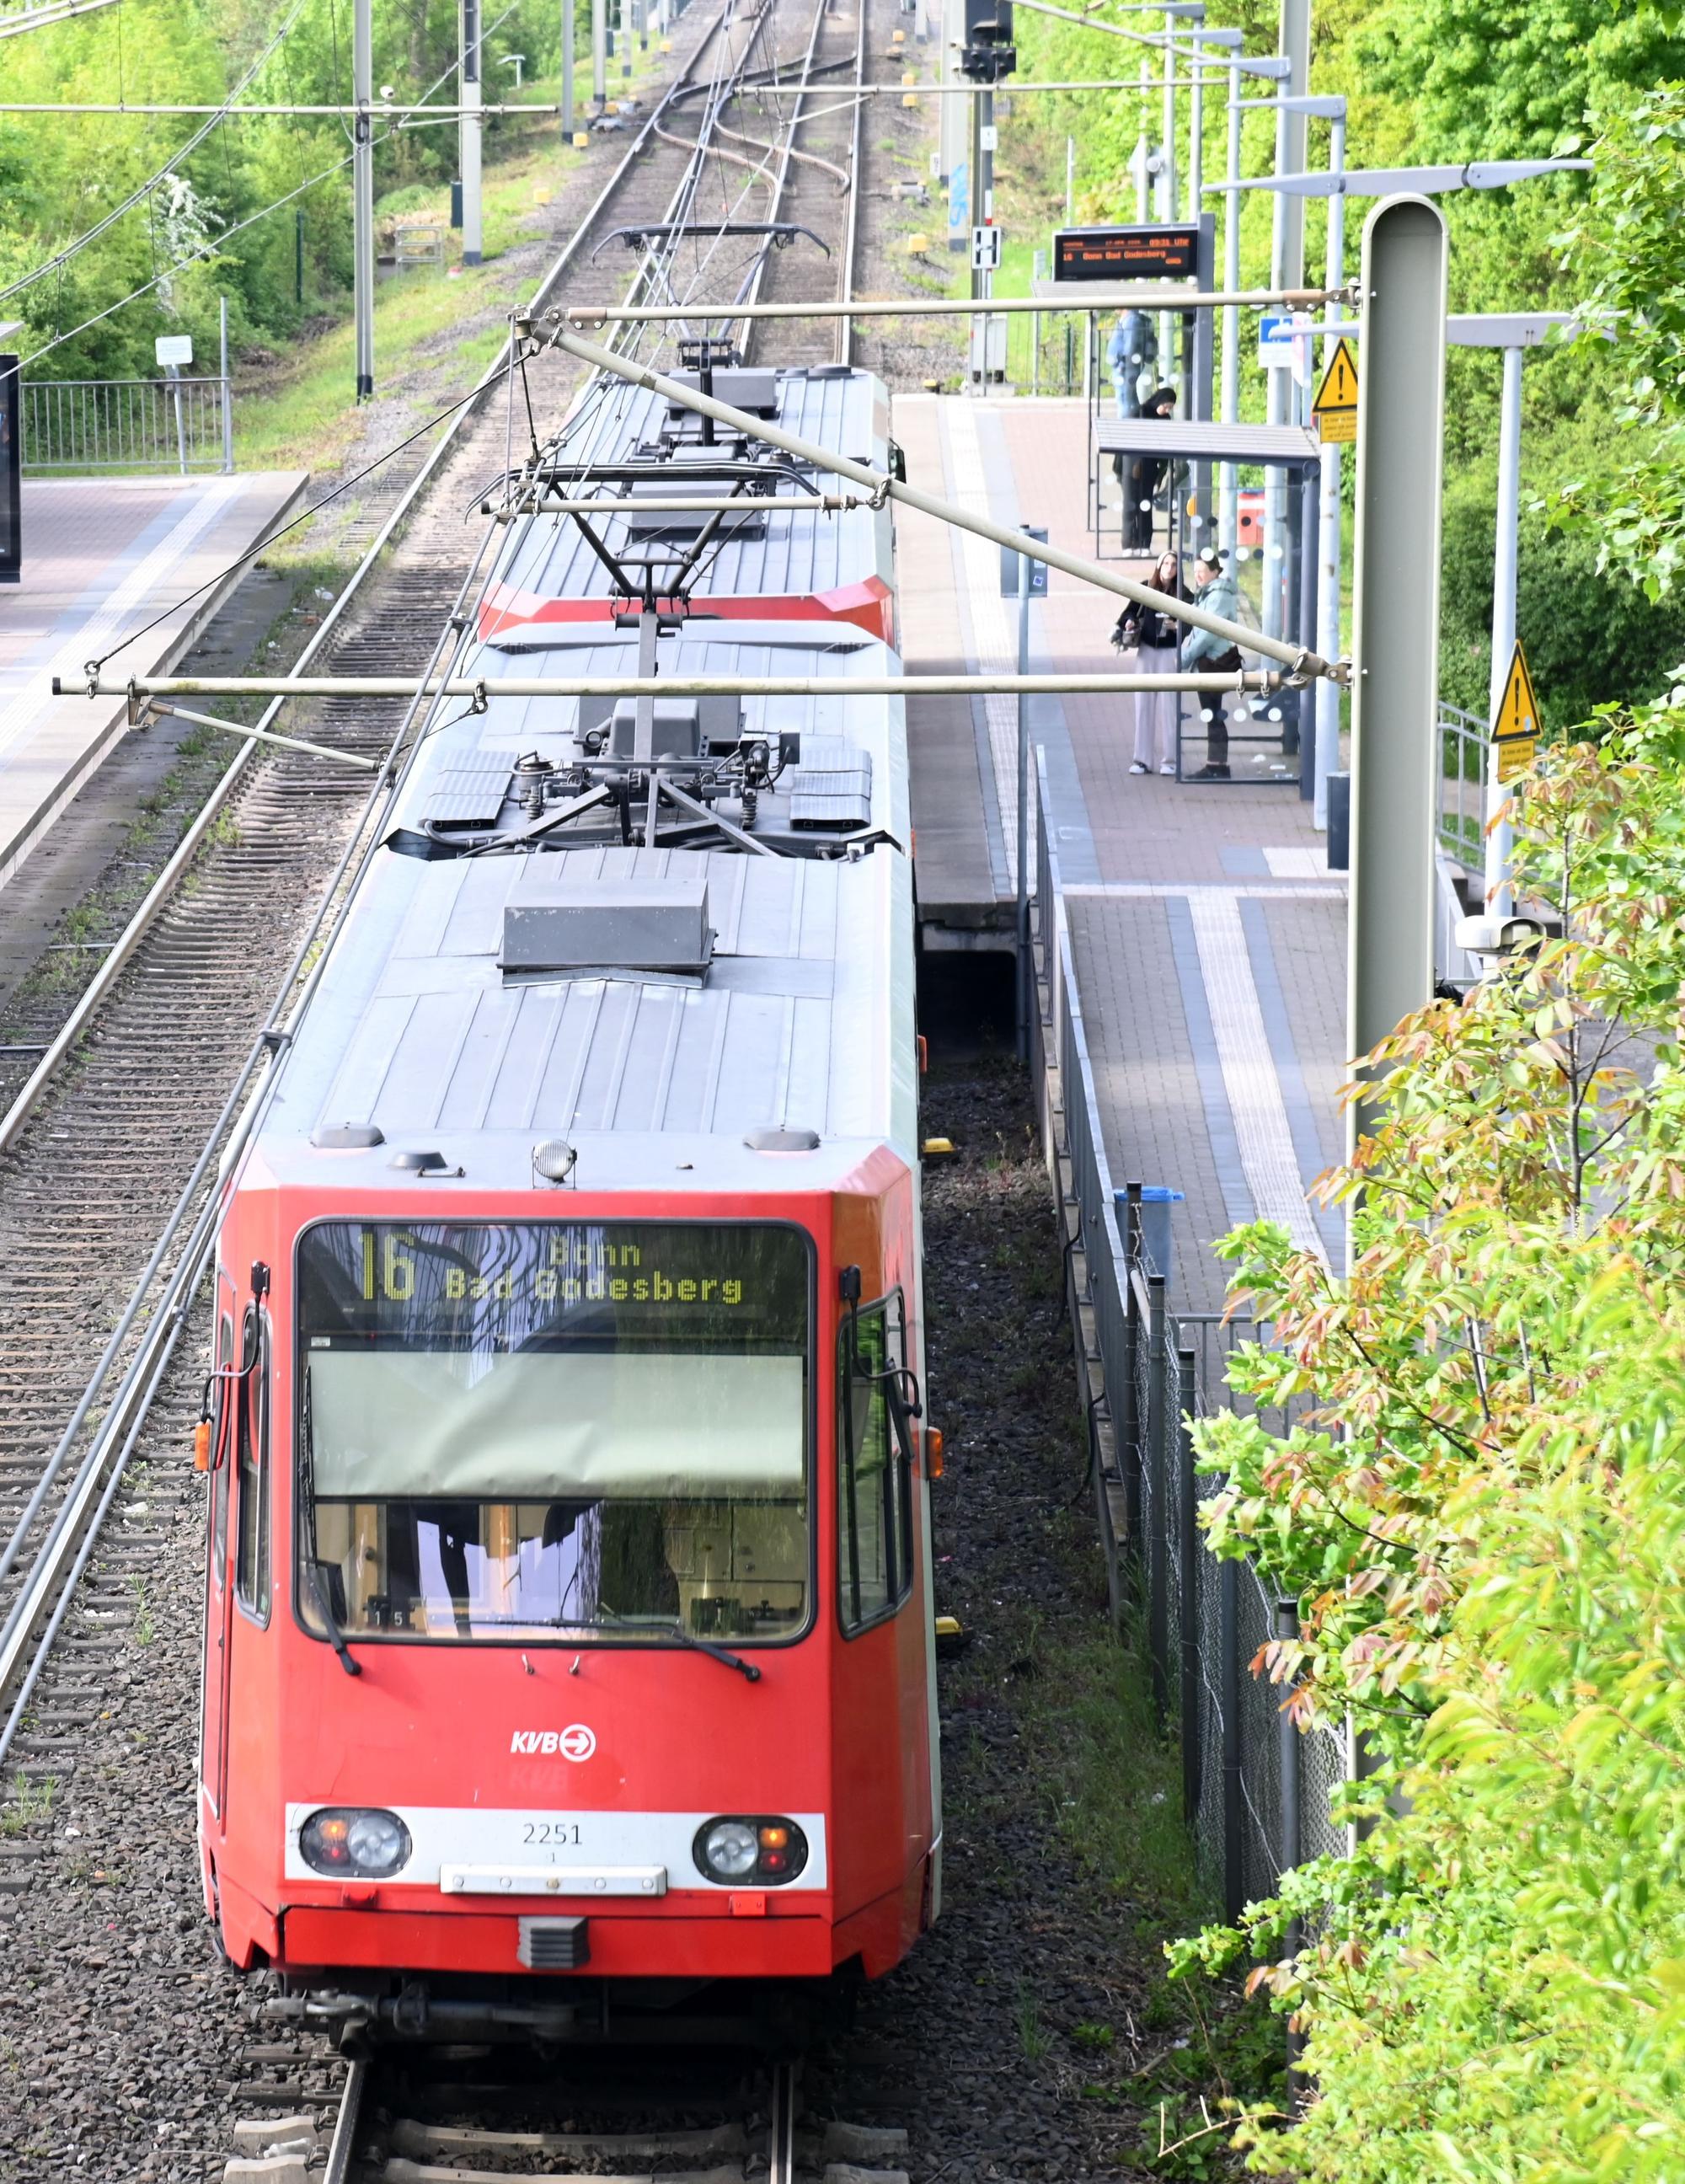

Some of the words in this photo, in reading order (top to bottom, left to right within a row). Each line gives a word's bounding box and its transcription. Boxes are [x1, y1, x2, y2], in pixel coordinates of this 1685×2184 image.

[1105, 251, 1121, 260] Bad
[1124, 250, 1166, 259] Godesberg
[550, 1235, 640, 1266] Bonn
[358, 1233, 415, 1301] 16
[446, 1268, 512, 1299] Bad
[535, 1269, 741, 1304] Godesberg
[511, 1731, 559, 1754] KVB
[522, 1823, 583, 1845] 2251
